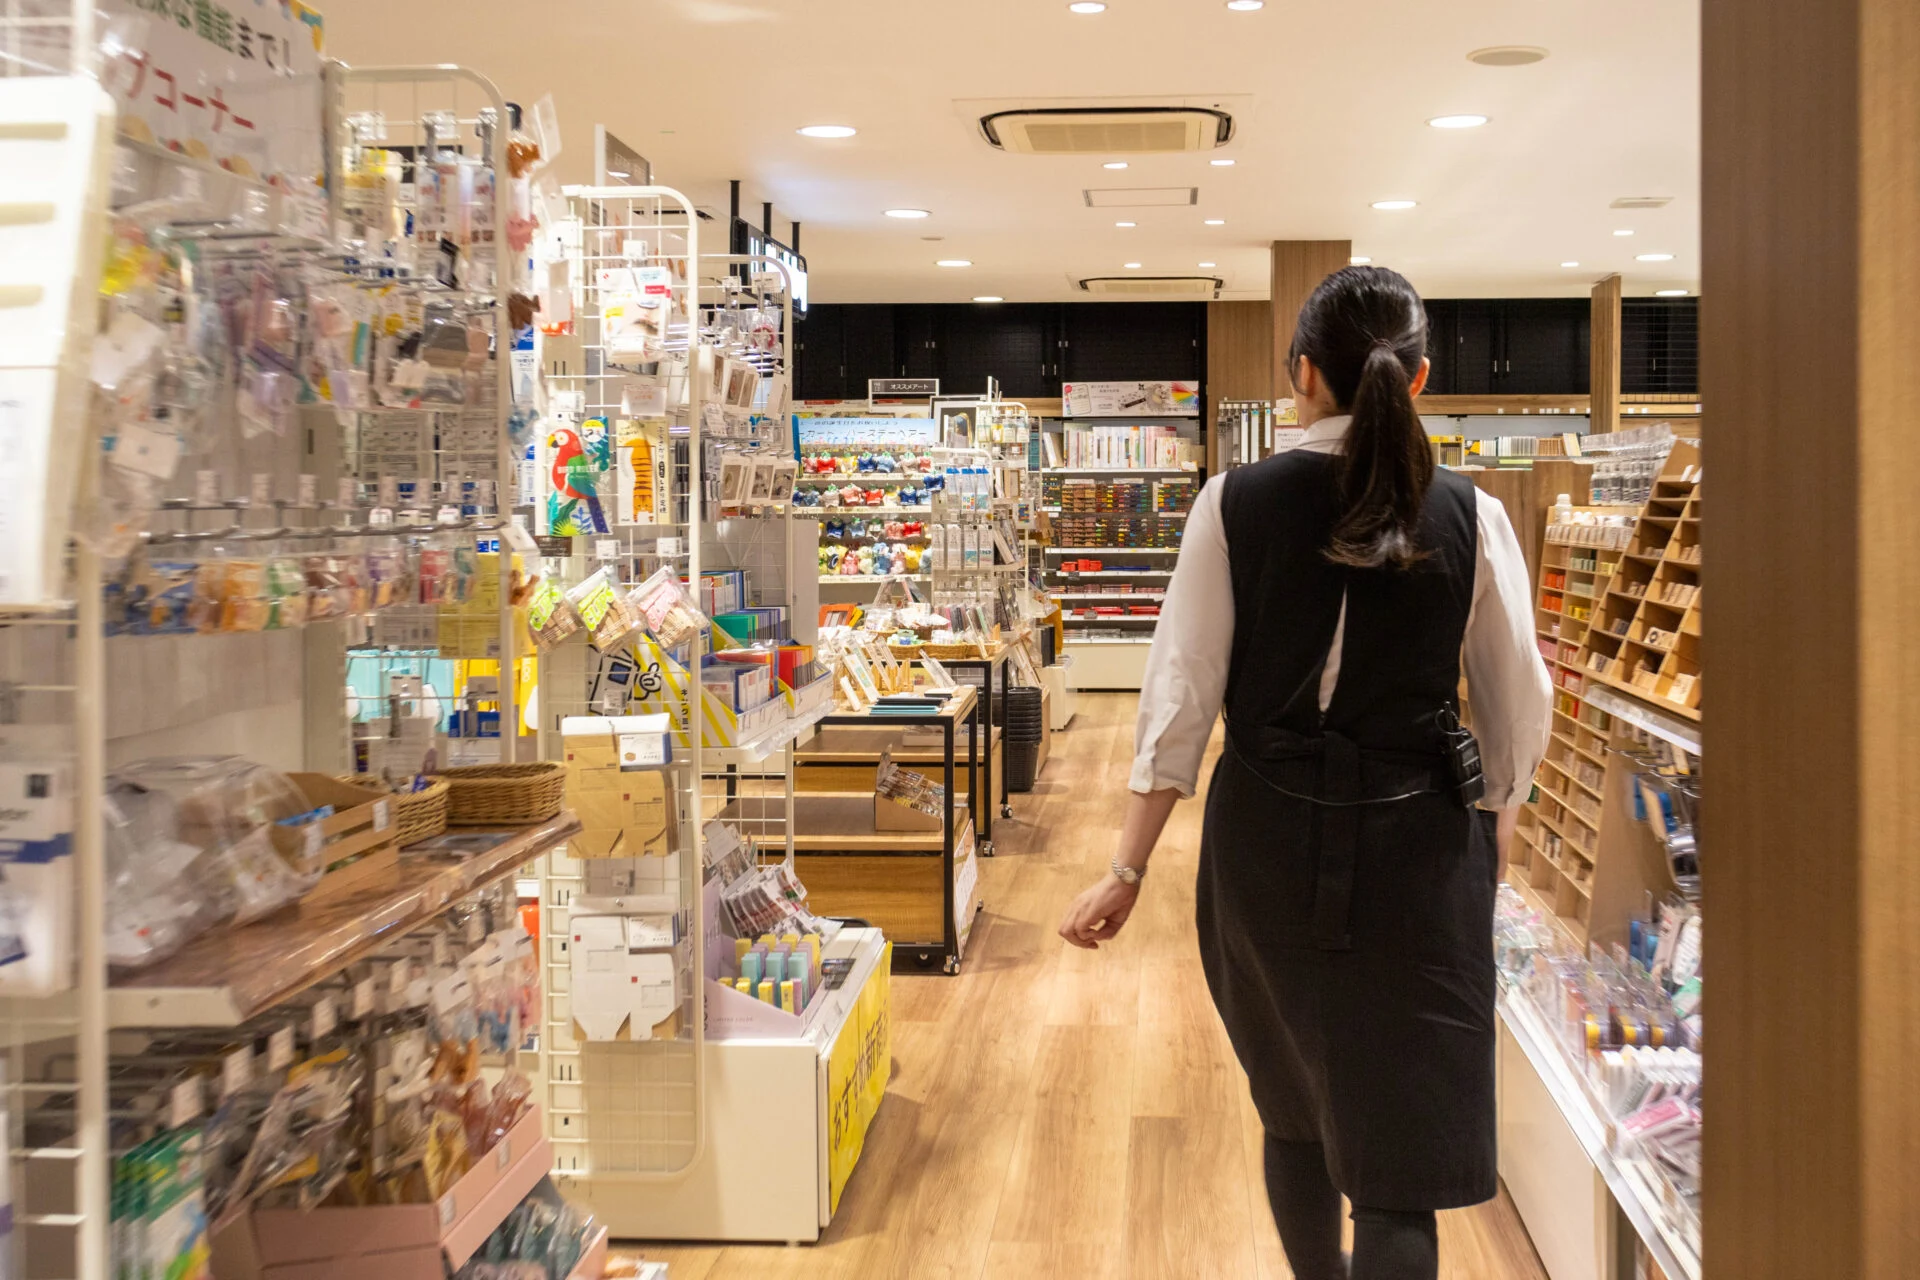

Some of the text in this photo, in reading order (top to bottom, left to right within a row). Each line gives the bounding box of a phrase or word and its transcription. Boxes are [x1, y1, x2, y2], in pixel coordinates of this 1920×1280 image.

[890, 383, 929, 391] オススメアート
